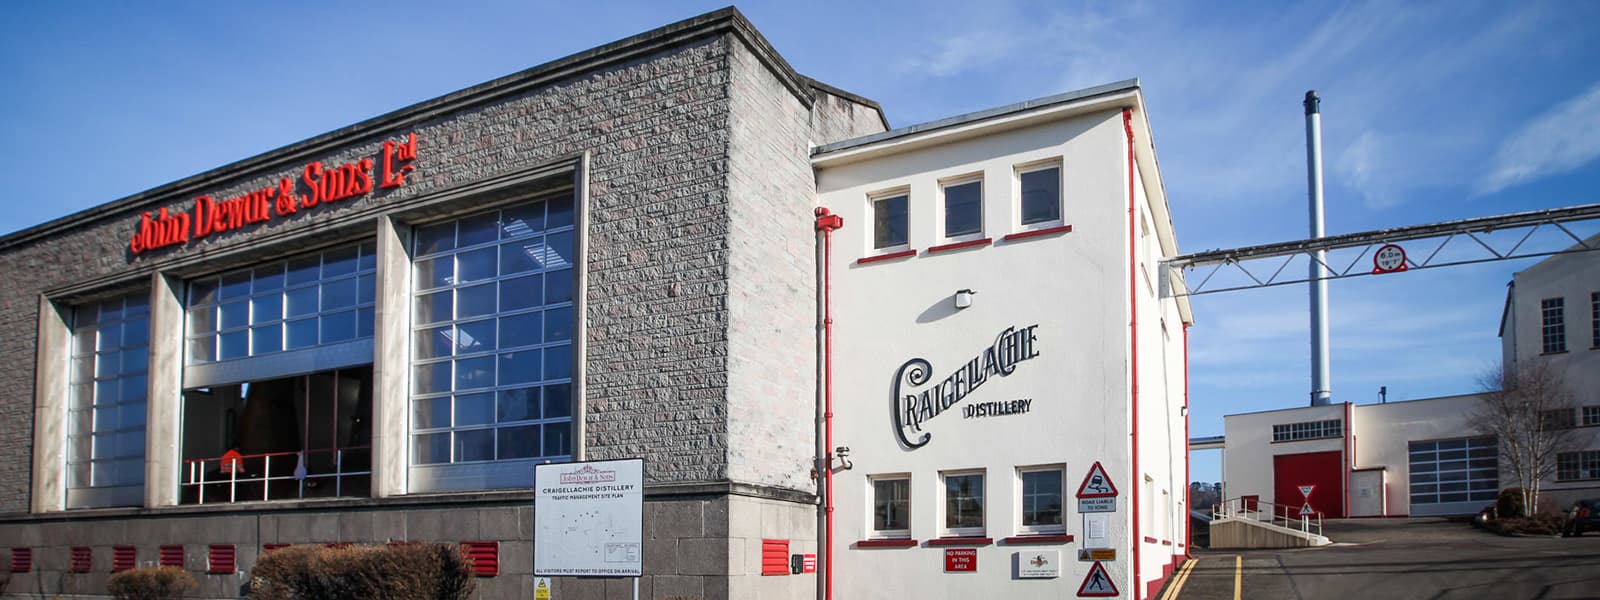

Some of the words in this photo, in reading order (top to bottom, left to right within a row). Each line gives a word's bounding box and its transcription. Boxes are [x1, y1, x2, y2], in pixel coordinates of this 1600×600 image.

[131, 208, 190, 253] John
[193, 195, 275, 239] Dewar
[275, 177, 297, 216] &
[300, 161, 373, 208] Sons
[966, 399, 1032, 418] DISTILLERY
[595, 484, 634, 492] DISTILLERY
